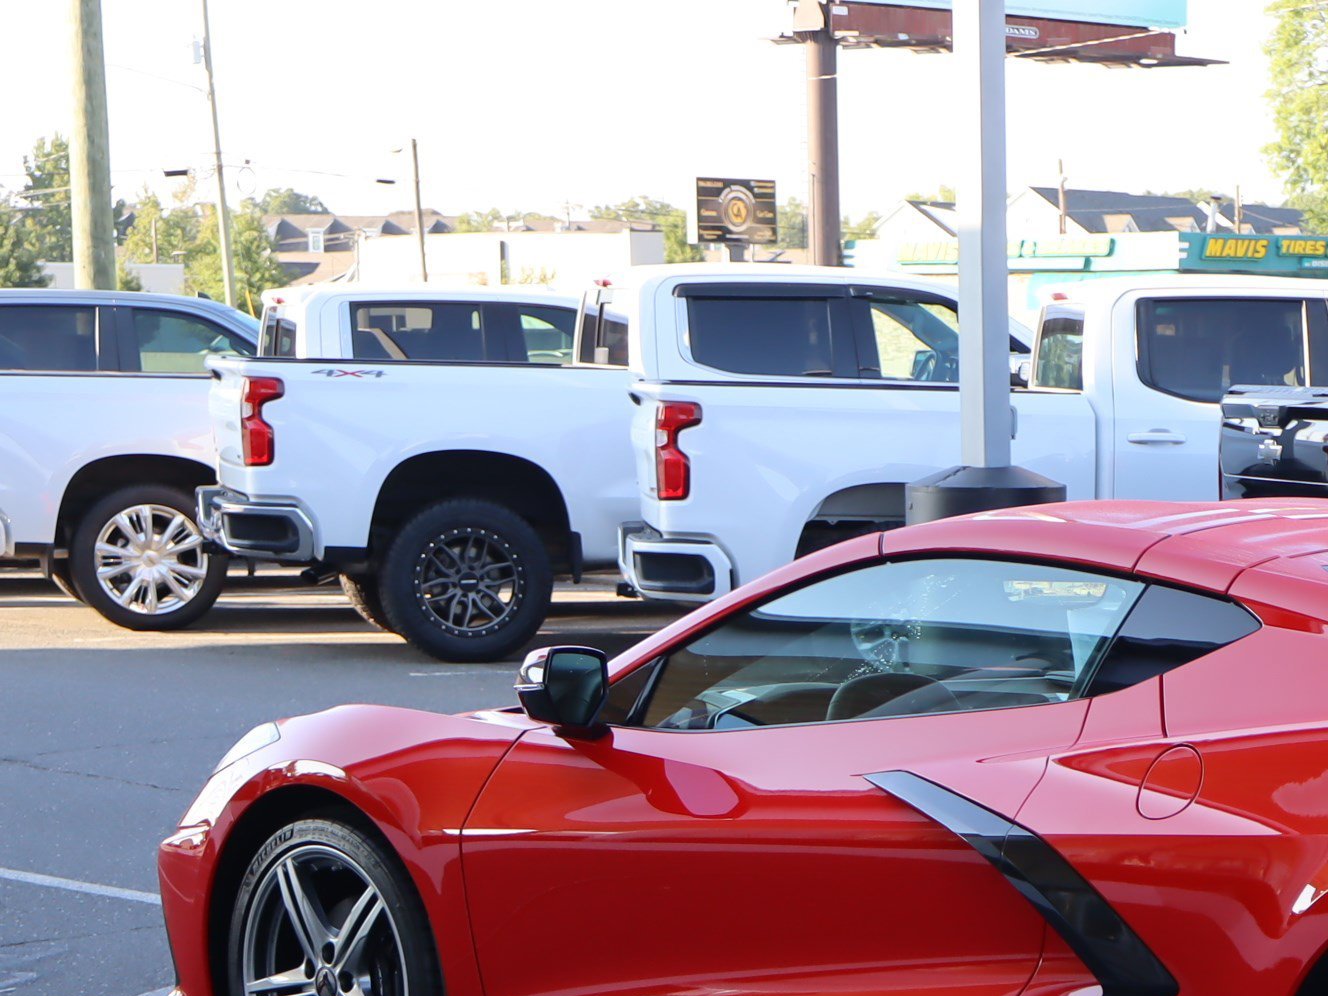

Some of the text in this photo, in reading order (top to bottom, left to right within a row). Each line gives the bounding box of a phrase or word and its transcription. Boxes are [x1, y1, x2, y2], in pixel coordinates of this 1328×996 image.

[1005, 27, 1037, 36] DAMS
[1205, 238, 1268, 258] MAVIS
[1280, 240, 1326, 255] TIRES
